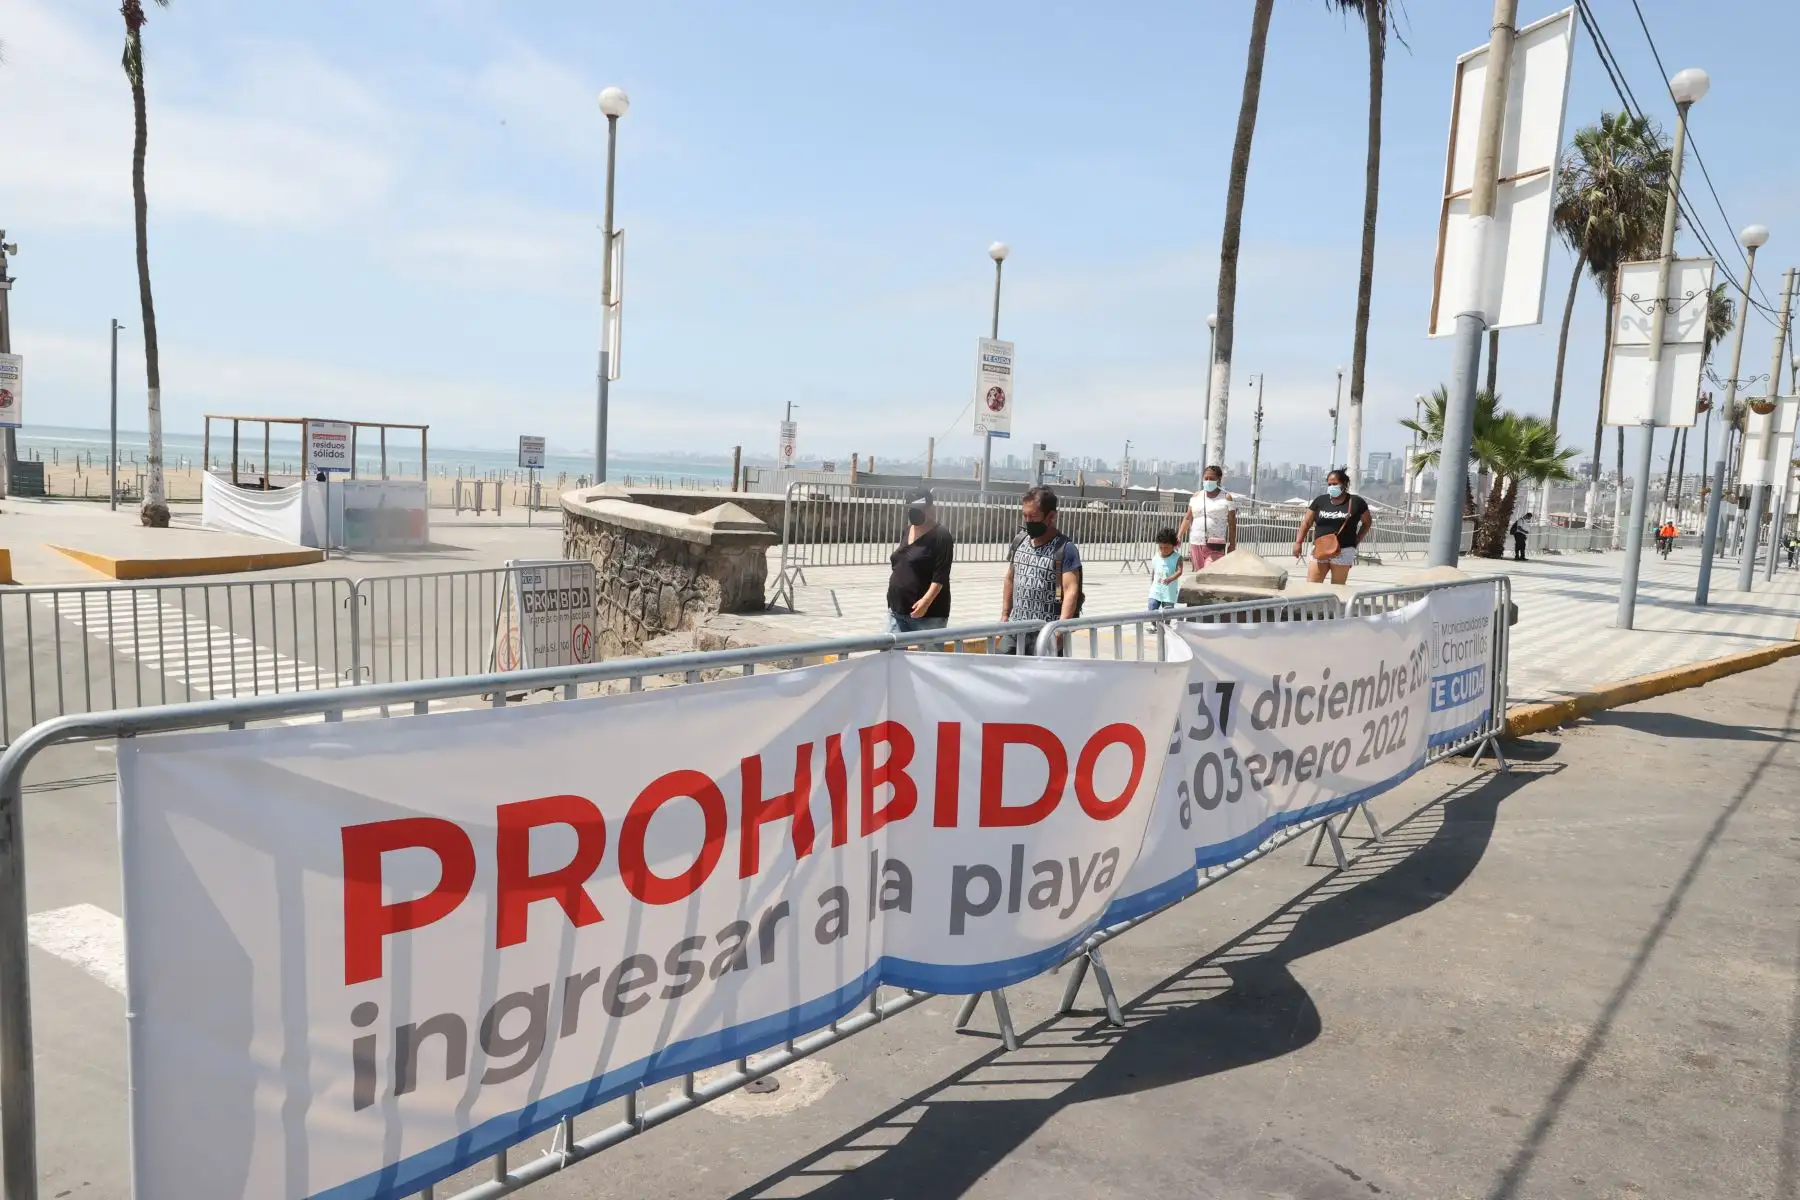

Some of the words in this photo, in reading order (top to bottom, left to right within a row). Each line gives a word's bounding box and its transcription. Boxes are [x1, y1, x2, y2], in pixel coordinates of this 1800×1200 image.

[313, 441, 345, 449] residuos
[313, 449, 345, 459] sólidos
[1442, 634, 1488, 665] Chorrillos
[1250, 660, 1408, 731] diciembre
[1450, 668, 1485, 703] CUIDA
[1244, 737, 1351, 791] enero
[1355, 705, 1409, 767] 2022
[341, 719, 1148, 985] PROHIBIDO
[350, 899, 790, 1113] ingresar
[814, 885, 850, 945] a
[868, 848, 913, 922] la
[949, 843, 1121, 936] playa
